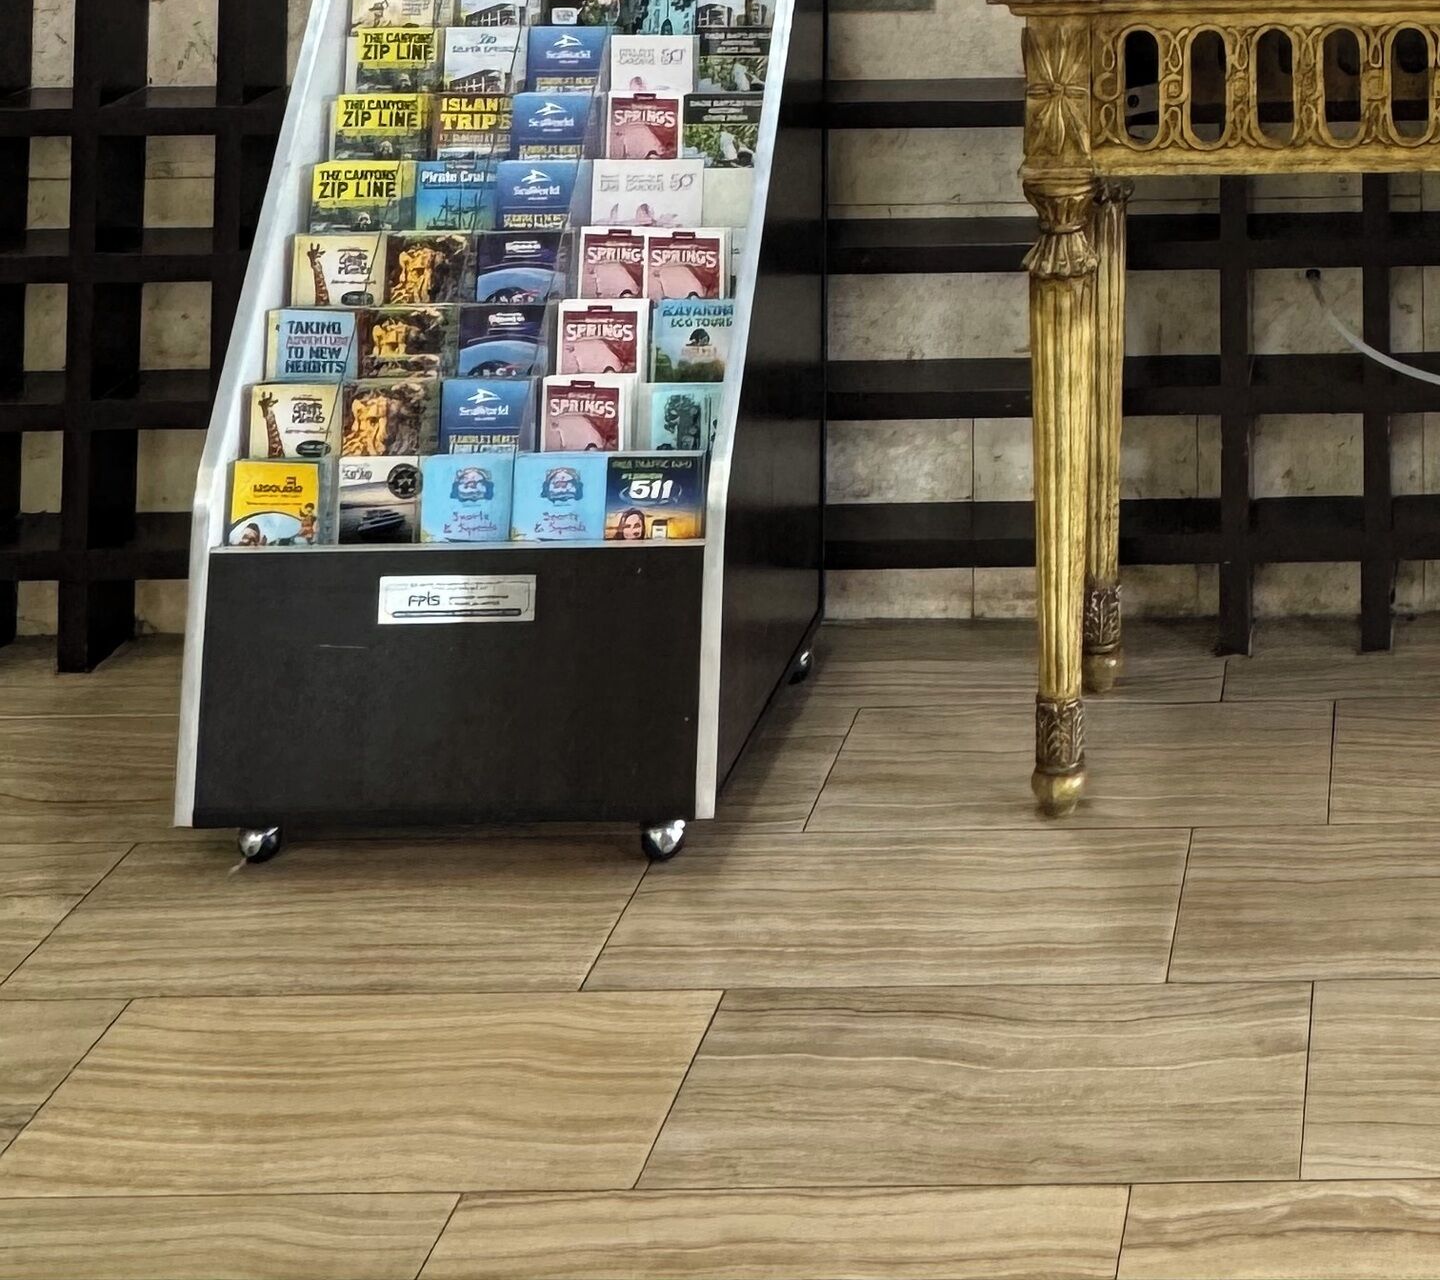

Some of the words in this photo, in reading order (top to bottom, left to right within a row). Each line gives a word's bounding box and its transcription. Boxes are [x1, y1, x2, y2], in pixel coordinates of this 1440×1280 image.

[362, 44, 391, 60] ZIP
[396, 44, 435, 60] LINE
[343, 112, 372, 128] ZIP
[378, 112, 418, 127] LINE
[614, 109, 676, 128] SPRINGS
[421, 170, 457, 183] Pirate
[319, 182, 348, 199] ZIP
[355, 182, 397, 198] LINE
[651, 249, 717, 268] SPRINGS
[287, 321, 342, 335] TAKING
[670, 318, 694, 328] ECO
[566, 324, 634, 342] SPRINGS
[287, 347, 305, 359] TO
[309, 347, 342, 359] NEW
[550, 400, 616, 419] SPRINGS
[628, 480, 674, 499] 511
